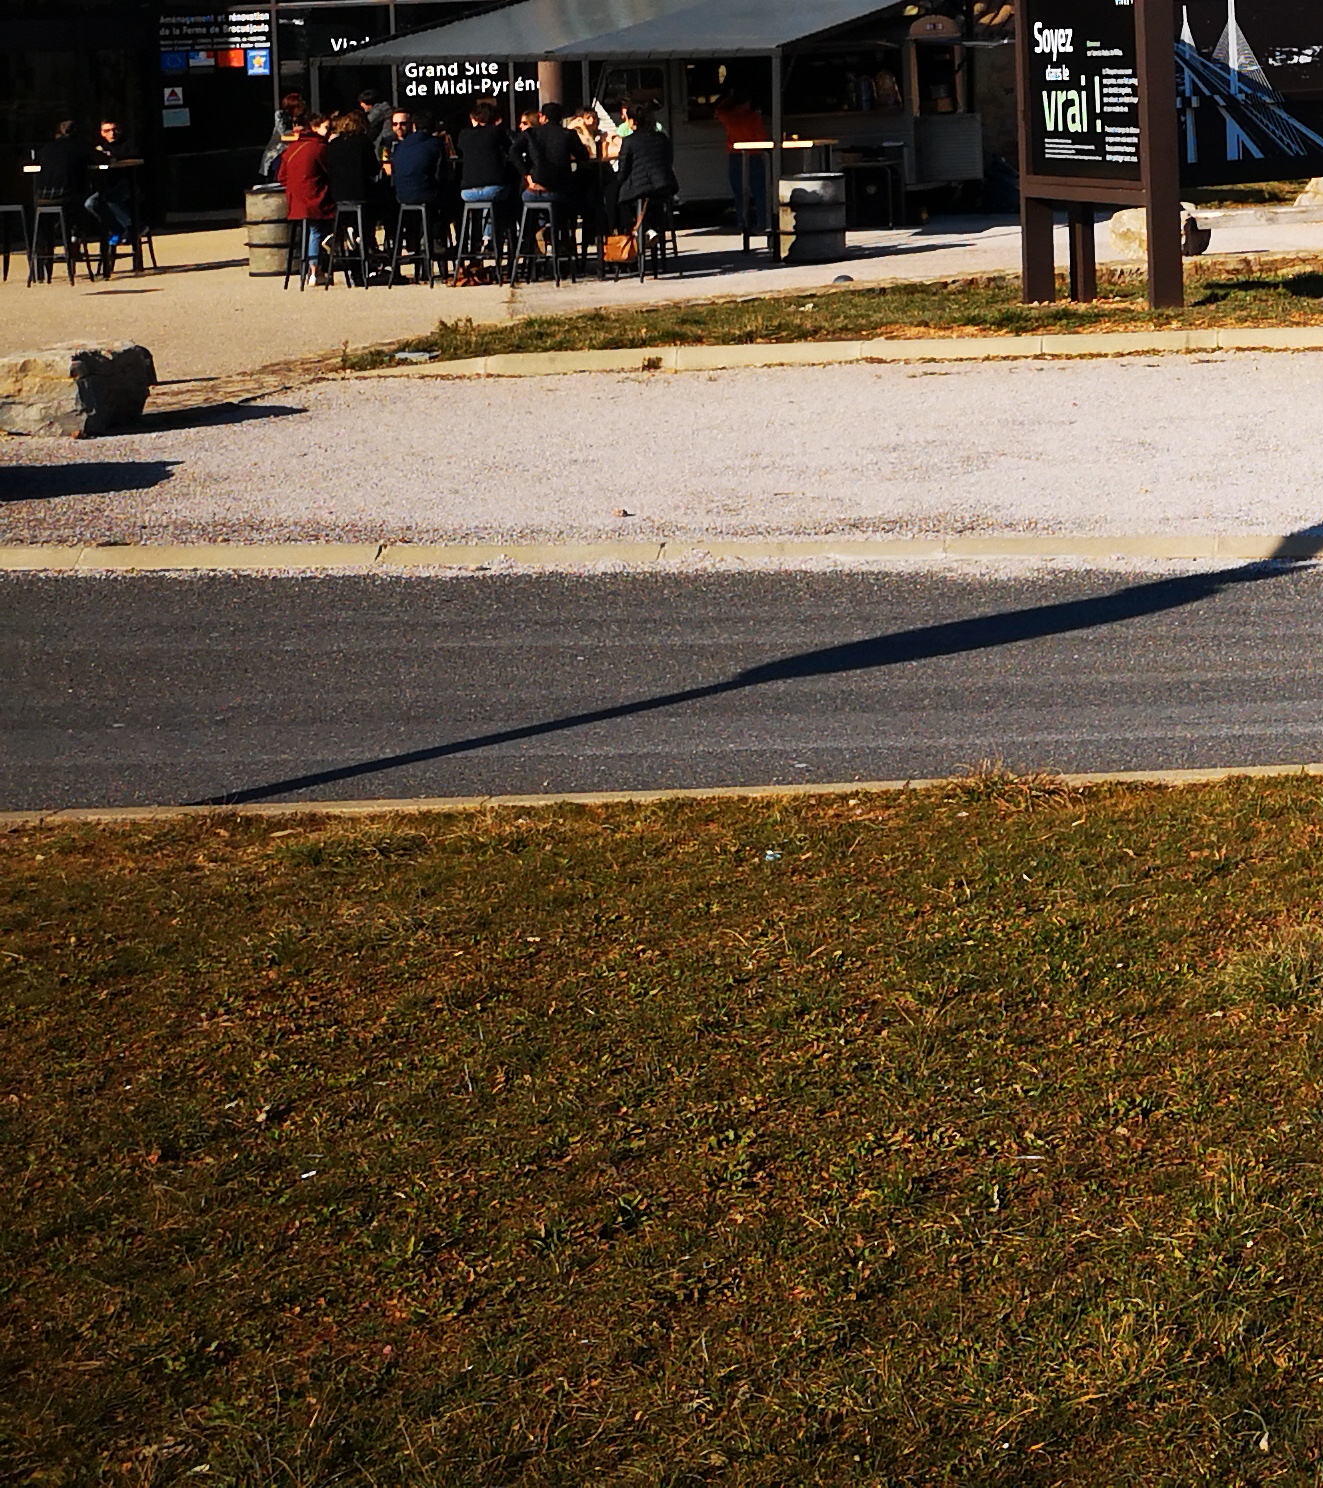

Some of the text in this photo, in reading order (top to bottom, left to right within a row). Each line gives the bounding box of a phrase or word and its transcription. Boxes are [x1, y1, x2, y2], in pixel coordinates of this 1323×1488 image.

[1033, 22, 1074, 62] Soyez
[405, 62, 498, 78] Grand Site
[405, 77, 540, 97] de Midi-Pyrén
[1042, 75, 1088, 132] vrai
